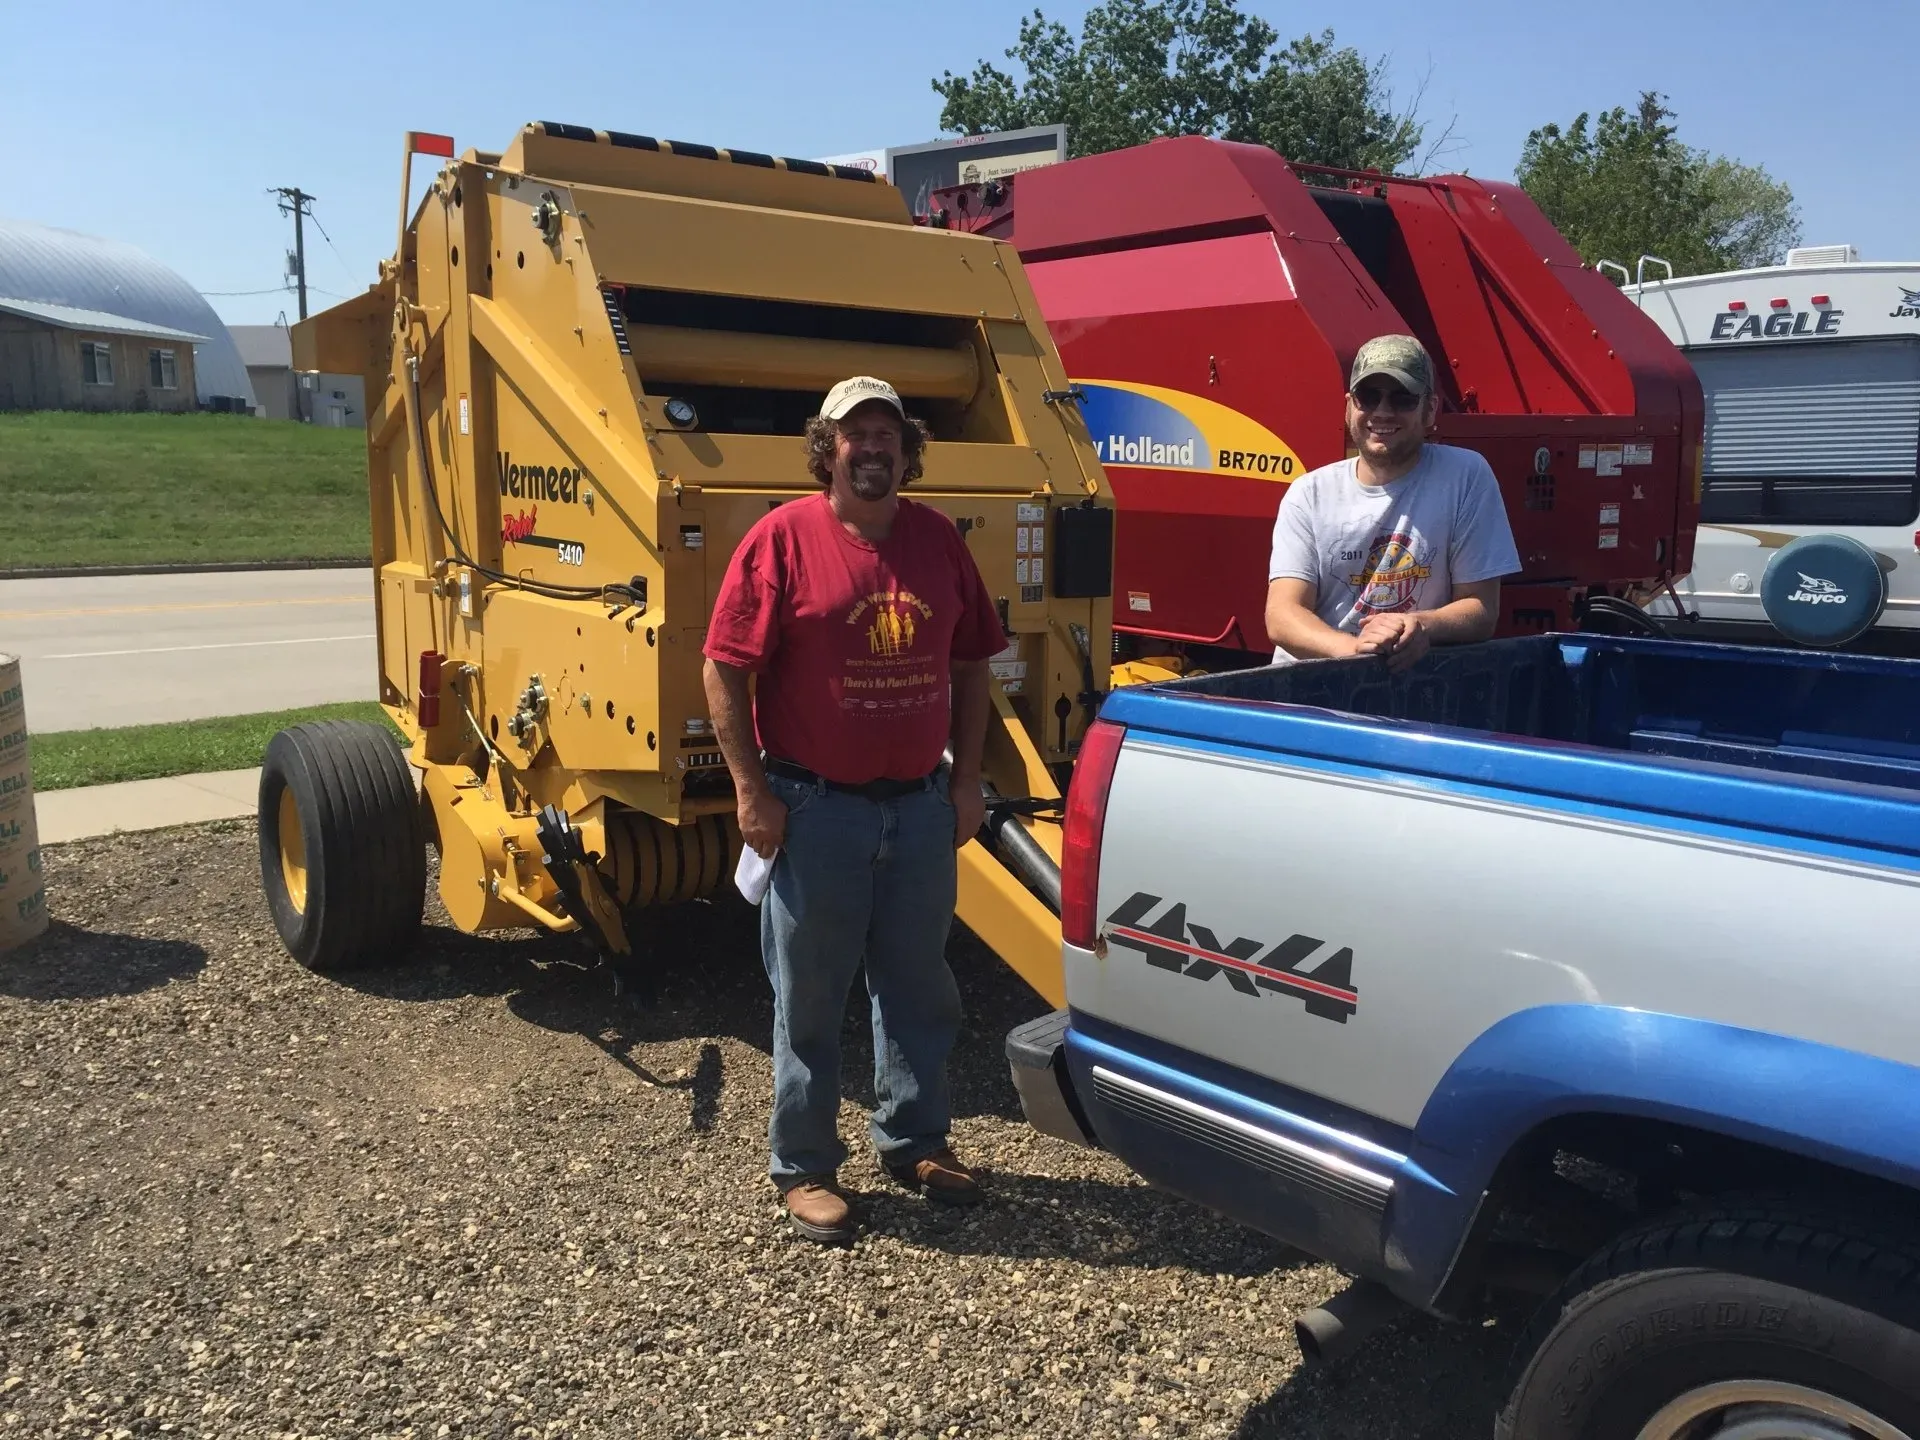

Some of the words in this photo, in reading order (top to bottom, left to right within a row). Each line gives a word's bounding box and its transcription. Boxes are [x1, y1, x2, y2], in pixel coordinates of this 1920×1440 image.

[1710, 309, 1844, 341] EAGLE
[844, 382, 856, 396] got
[1109, 434, 1195, 466] Holland
[1218, 449, 1293, 476] BR7070
[497, 451, 580, 504] Vermeer
[558, 543, 583, 566] 5410
[1341, 550, 1363, 561] 2011
[1787, 590, 1847, 605] Jayco
[842, 676, 874, 689] There's
[886, 676, 907, 688] Place
